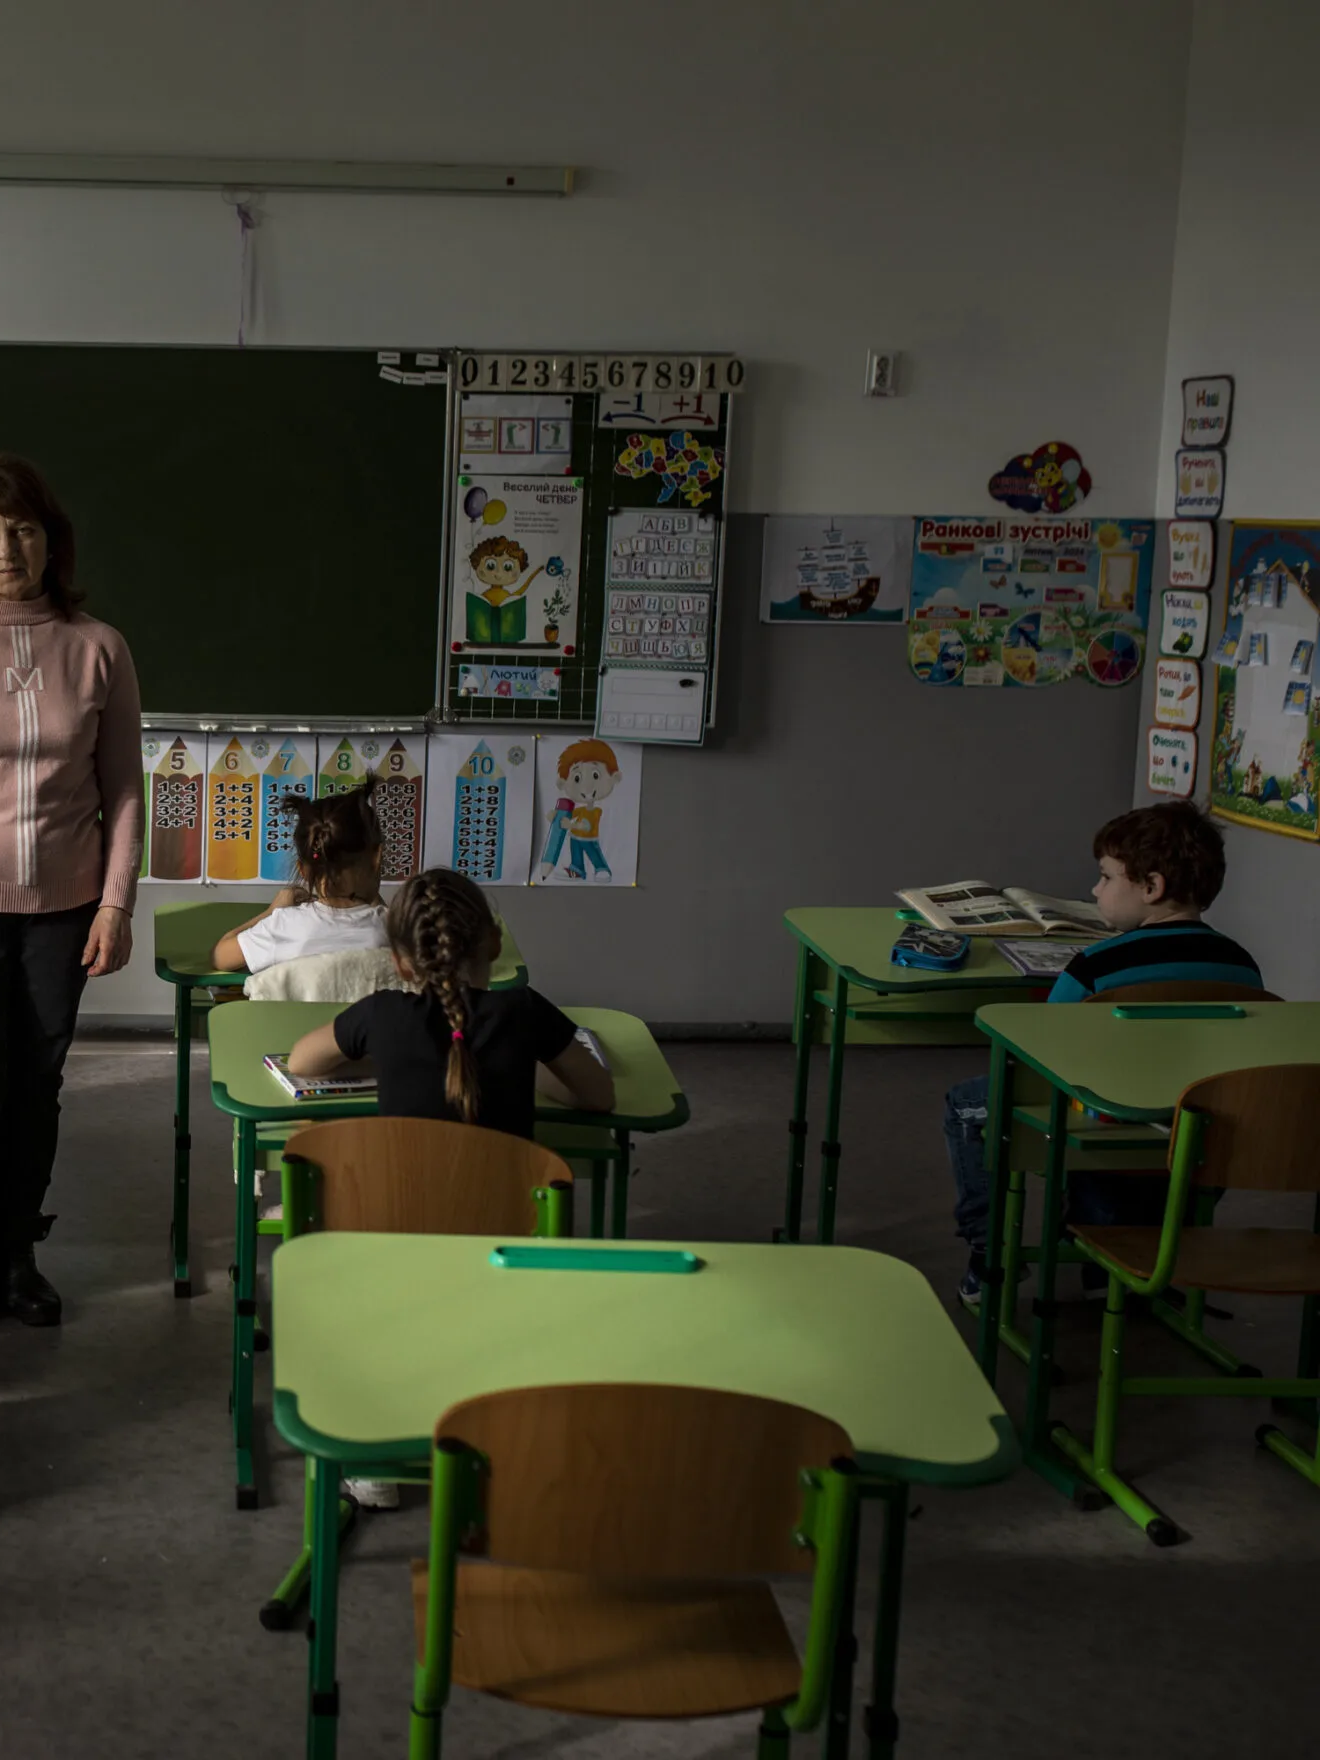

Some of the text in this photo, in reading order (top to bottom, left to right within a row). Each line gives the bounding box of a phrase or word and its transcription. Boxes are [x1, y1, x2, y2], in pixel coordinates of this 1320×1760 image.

[461, 357, 478, 387] 0
[488, 360, 499, 385] 1
[511, 359, 527, 385] 2
[534, 360, 550, 386] 3
[559, 360, 575, 387] 4
[582, 362, 598, 389] 5
[608, 360, 624, 387] 6
[632, 362, 647, 388] 7
[655, 362, 672, 389] 8
[679, 362, 695, 387] 9
[503, 482, 578, 494] Веселий день
[536, 494, 578, 504] ЧЕТВЕР
[922, 521, 1089, 541] Ранкові зустрічі
[7, 667, 44, 692] M
[171, 752, 185, 770] 5
[225, 752, 238, 770] 6
[280, 753, 295, 771] 7
[337, 753, 351, 771] 8
[390, 754, 404, 772] 9
[469, 756, 494, 775] 10
[158, 782, 197, 792] 1+4
[215, 783, 253, 793] 1+5
[268, 783, 307, 793] 1+6
[377, 785, 415, 794] 1+8
[462, 785, 499, 794] 1+9
[157, 795, 196, 804] 2+3
[215, 795, 254, 805] 2+4
[377, 797, 415, 806] 2+7
[461, 796, 498, 805] 2+8
[157, 806, 196, 816] 3+2
[215, 807, 253, 817] 3+3
[377, 808, 414, 817] 3+6
[460, 806, 498, 815] 3+7
[156, 818, 195, 828] 4+1
[214, 819, 253, 828] 4+2
[460, 817, 497, 826] 4+6
[214, 831, 251, 840] 5+1
[460, 828, 497, 837] 5+5
[459, 838, 496, 847] 6+4
[458, 849, 496, 858] 7+3
[458, 859, 495, 868] 8+2
